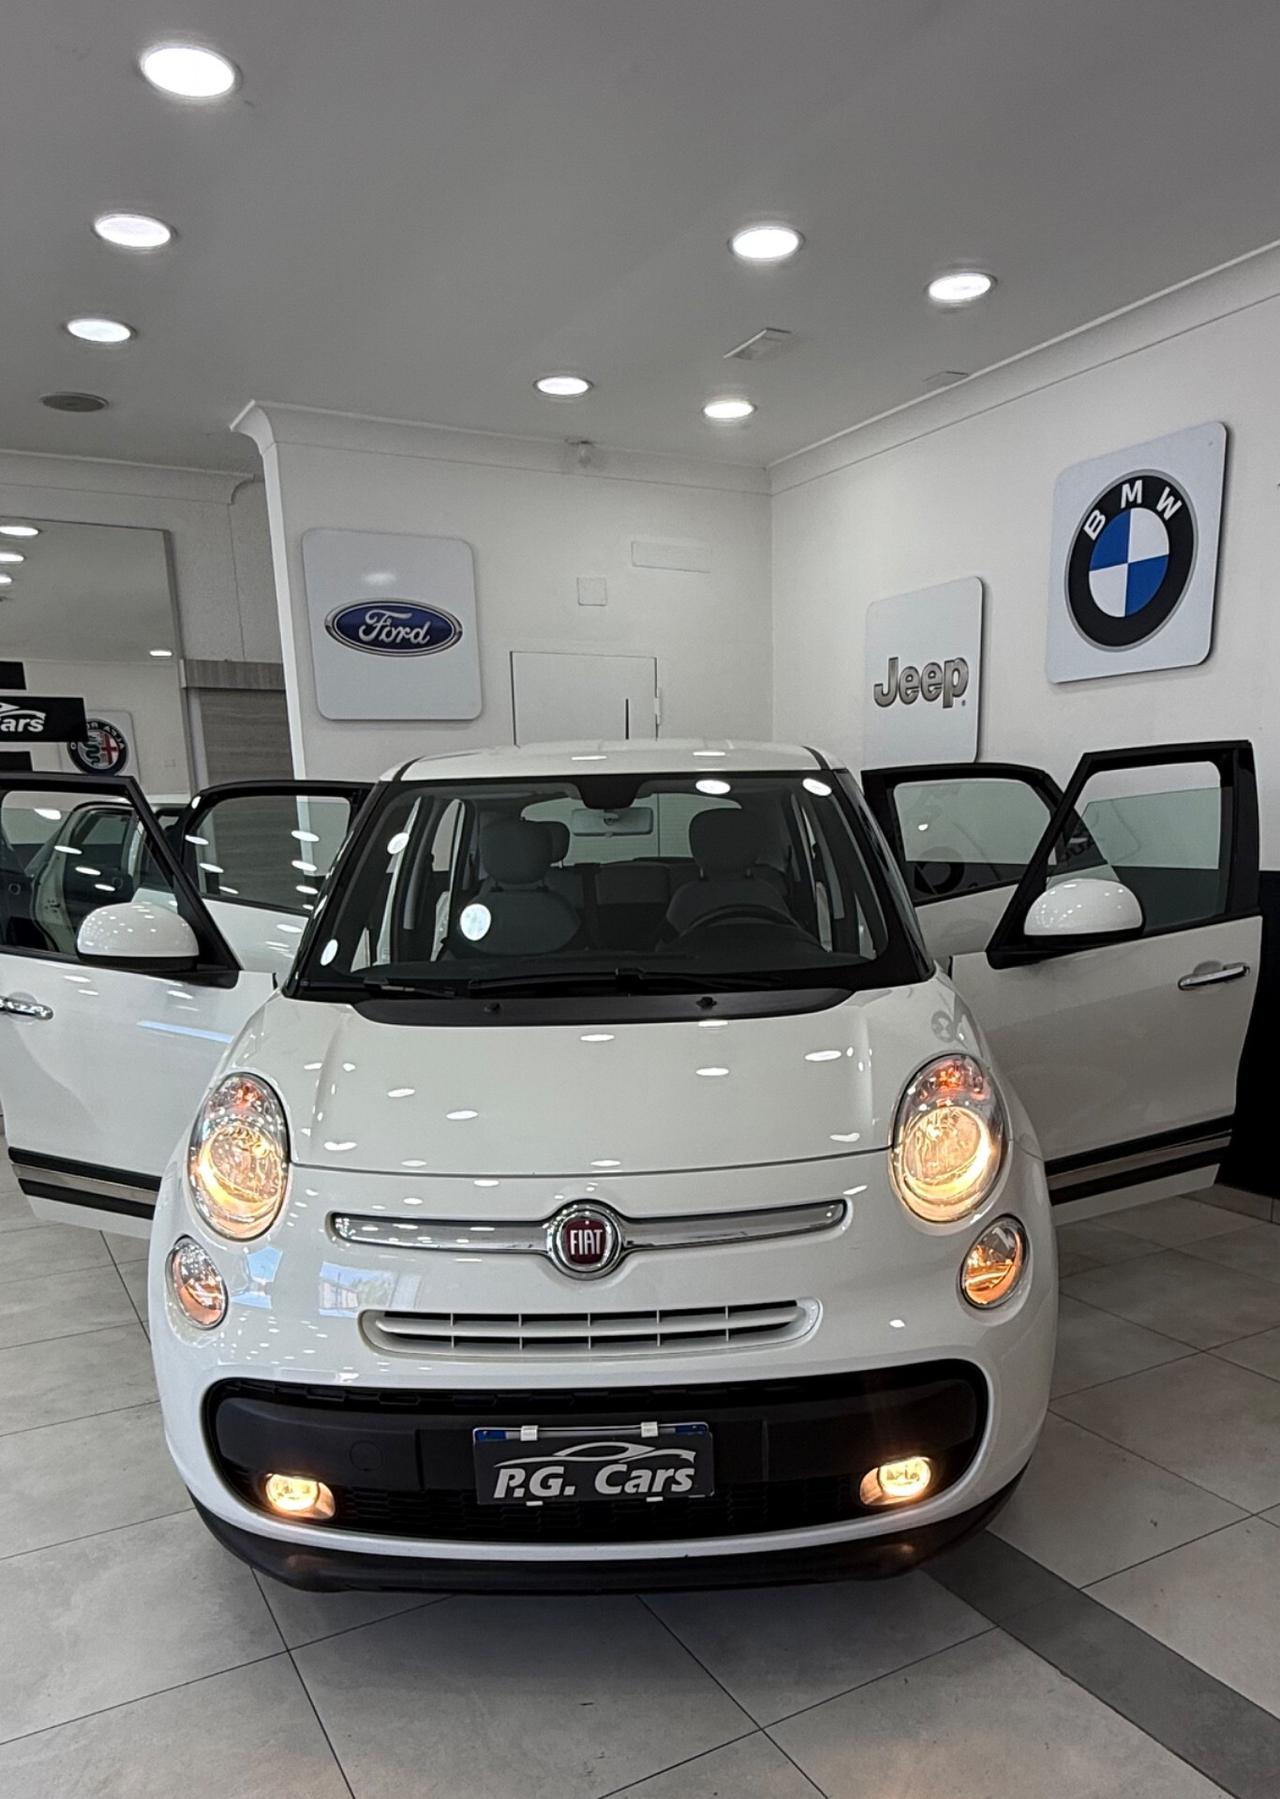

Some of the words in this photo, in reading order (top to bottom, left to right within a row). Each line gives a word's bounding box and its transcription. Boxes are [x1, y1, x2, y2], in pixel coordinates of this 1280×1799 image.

[1083, 479, 1182, 541] BMW
[358, 609, 432, 645] Ford
[873, 656, 969, 709] Jeep
[0, 718, 45, 732] ars
[570, 1229, 603, 1255] FIAT
[493, 1465, 576, 1498] P.G.
[594, 1463, 695, 1495] Cars
